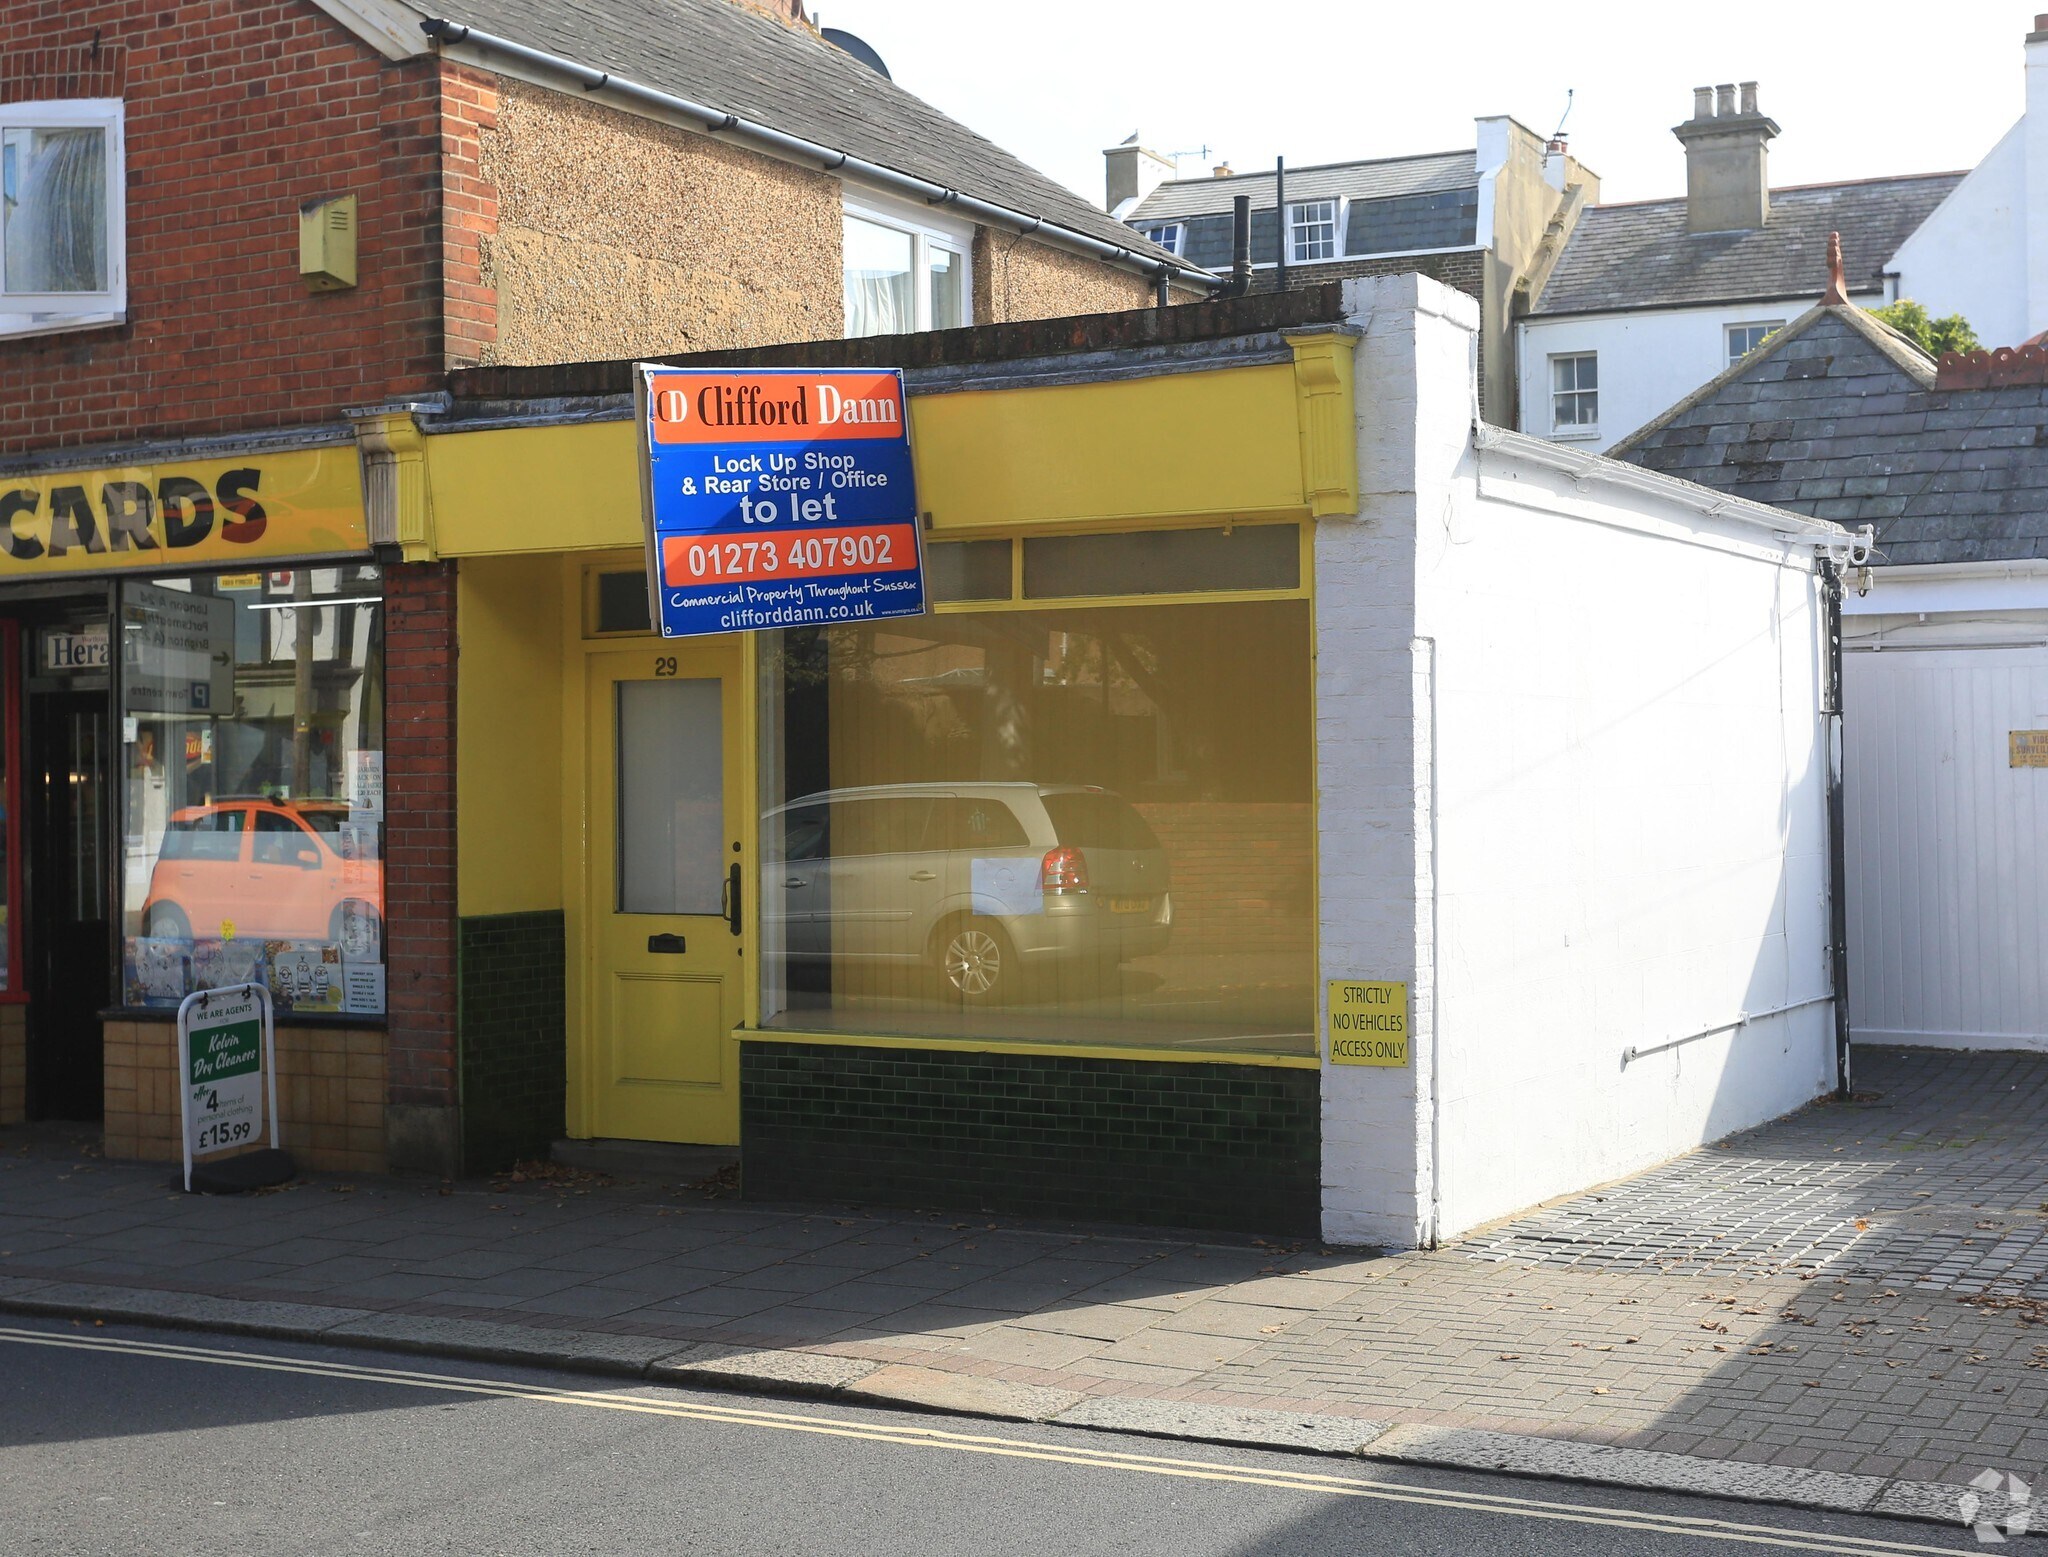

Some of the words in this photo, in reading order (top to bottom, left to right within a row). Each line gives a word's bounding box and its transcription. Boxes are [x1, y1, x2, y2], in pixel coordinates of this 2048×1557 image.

[697, 385, 809, 427] Clifford
[815, 384, 898, 424] Dann
[713, 454, 763, 473] Lock
[769, 453, 797, 474] Up
[804, 452, 855, 472] Shop
[681, 476, 698, 496] &
[705, 475, 751, 494] Rear
[758, 473, 811, 492] Store
[831, 471, 888, 489] Office
[0, 468, 268, 560] CARDS
[740, 495, 778, 523] to
[790, 492, 837, 522] let
[688, 542, 779, 577] 01273
[788, 534, 893, 569] 407902
[670, 585, 744, 609] Commercial
[746, 586, 802, 606] Property
[805, 583, 871, 598] Throughout
[873, 578, 917, 592] Sussex
[720, 600, 876, 628] clifforddann.co.uk
[655, 657, 677, 677] 29
[1343, 986, 1392, 1004] STRICTLY
[197, 1011, 208, 1021] WE
[210, 1009, 223, 1018] ARE
[226, 1004, 252, 1016] AGENTS
[1333, 1013, 1350, 1030] NO
[1352, 1014, 1403, 1031] VEHICLES
[208, 1033, 239, 1053] Kelvin
[1333, 1040, 1373, 1057] ACCESS
[1375, 1041, 1405, 1059] ONLY
[194, 1058, 213, 1078] Dry
[215, 1049, 256, 1070] Cleaners
[206, 1090, 219, 1112] 4
[199, 1122, 250, 1148] £15.99
